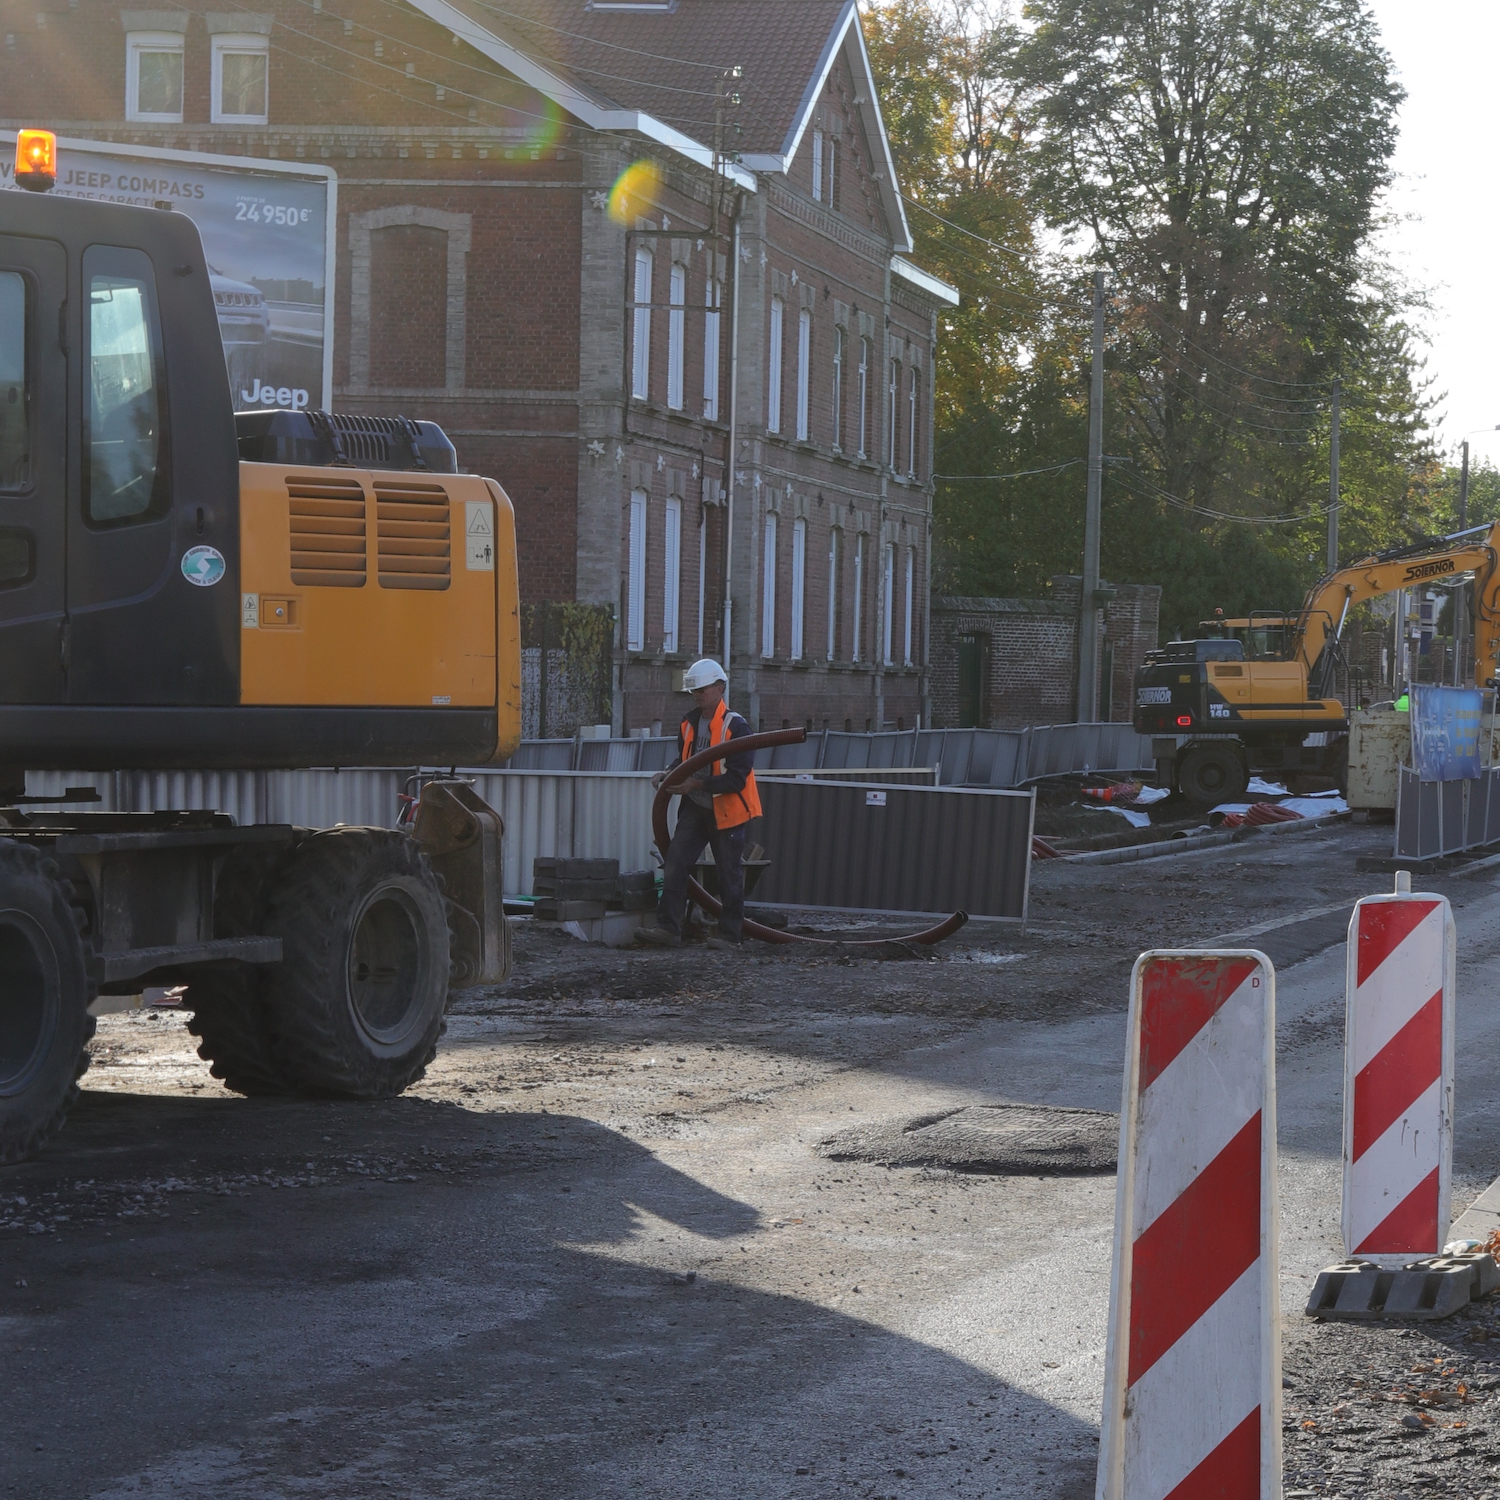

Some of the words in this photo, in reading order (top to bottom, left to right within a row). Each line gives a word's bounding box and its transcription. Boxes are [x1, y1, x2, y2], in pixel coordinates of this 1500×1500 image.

[64, 169, 111, 188] JEEP
[117, 174, 206, 200] COMPASS
[241, 378, 309, 411] Jeep
[1402, 558, 1456, 583] SOTERNOR
[1210, 709, 1230, 718] 140
[1252, 977, 1260, 988] D
